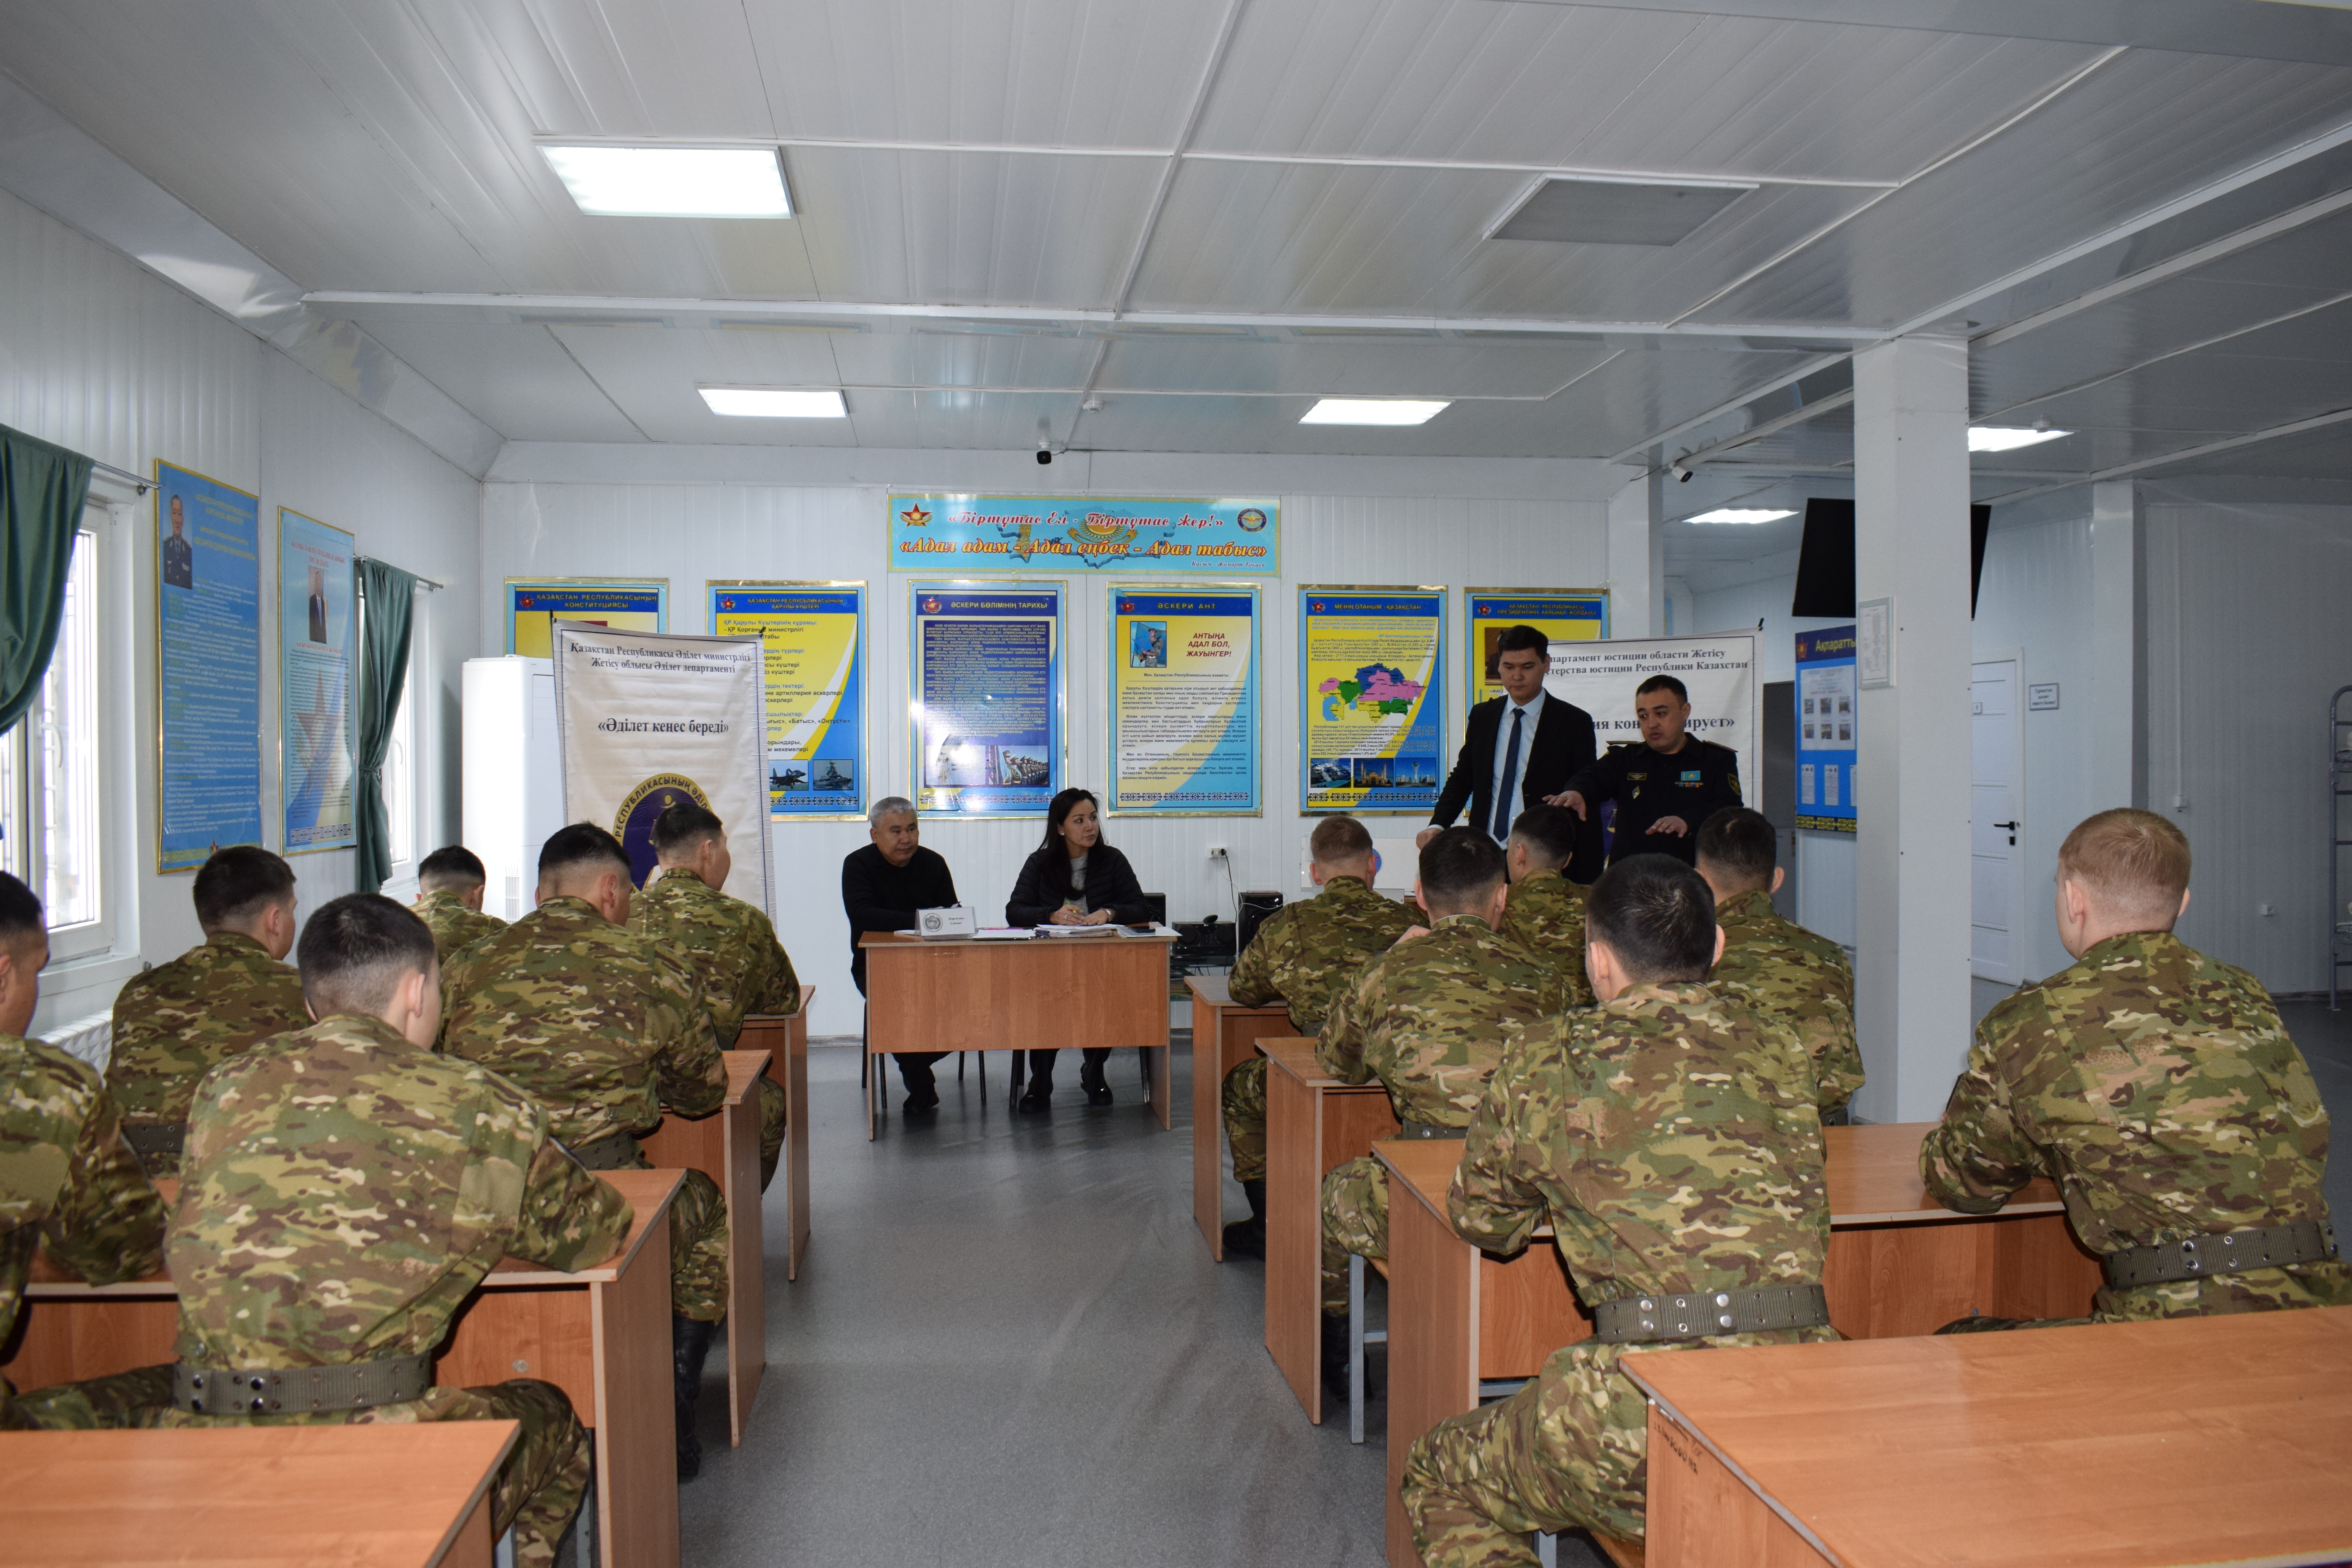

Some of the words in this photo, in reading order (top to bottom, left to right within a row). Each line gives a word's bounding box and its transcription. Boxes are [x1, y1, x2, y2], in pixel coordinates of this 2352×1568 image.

[948, 511, 1042, 527] «Біртұтас
[1046, 512, 1068, 524] Ел
[1085, 512, 1170, 530] Біртұтас
[900, 537, 957, 554] «Адал
[962, 538, 1008, 554] адам
[1025, 539, 1072, 554] Адал
[1076, 540, 1129, 556] еңбек
[1145, 540, 1192, 556] Адал
[1197, 541, 1267, 557] табыс»
[570, 642, 614, 654] Қазақстан
[617, 646, 673, 658] Республикасы
[676, 650, 701, 659] Әділет
[704, 651, 750, 662] министрлігі
[1550, 655, 1601, 664] партамент
[1650, 651, 1688, 659] области
[1691, 650, 1726, 659] Жетісу
[591, 657, 618, 669] Жетісу
[621, 659, 652, 669] облысы
[654, 661, 681, 671] Әділет
[683, 664, 735, 674] департаменті
[1635, 662, 1693, 673] Республики
[1696, 661, 1748, 670] Казахстан
[598, 718, 648, 732] «Әділет
[652, 722, 685, 733] кеңес
[689, 720, 729, 736] береді»
[615, 776, 691, 837] РЕСПУБЛИКАСЫНЫҢ
[692, 788, 709, 809] ӘДІЛ
